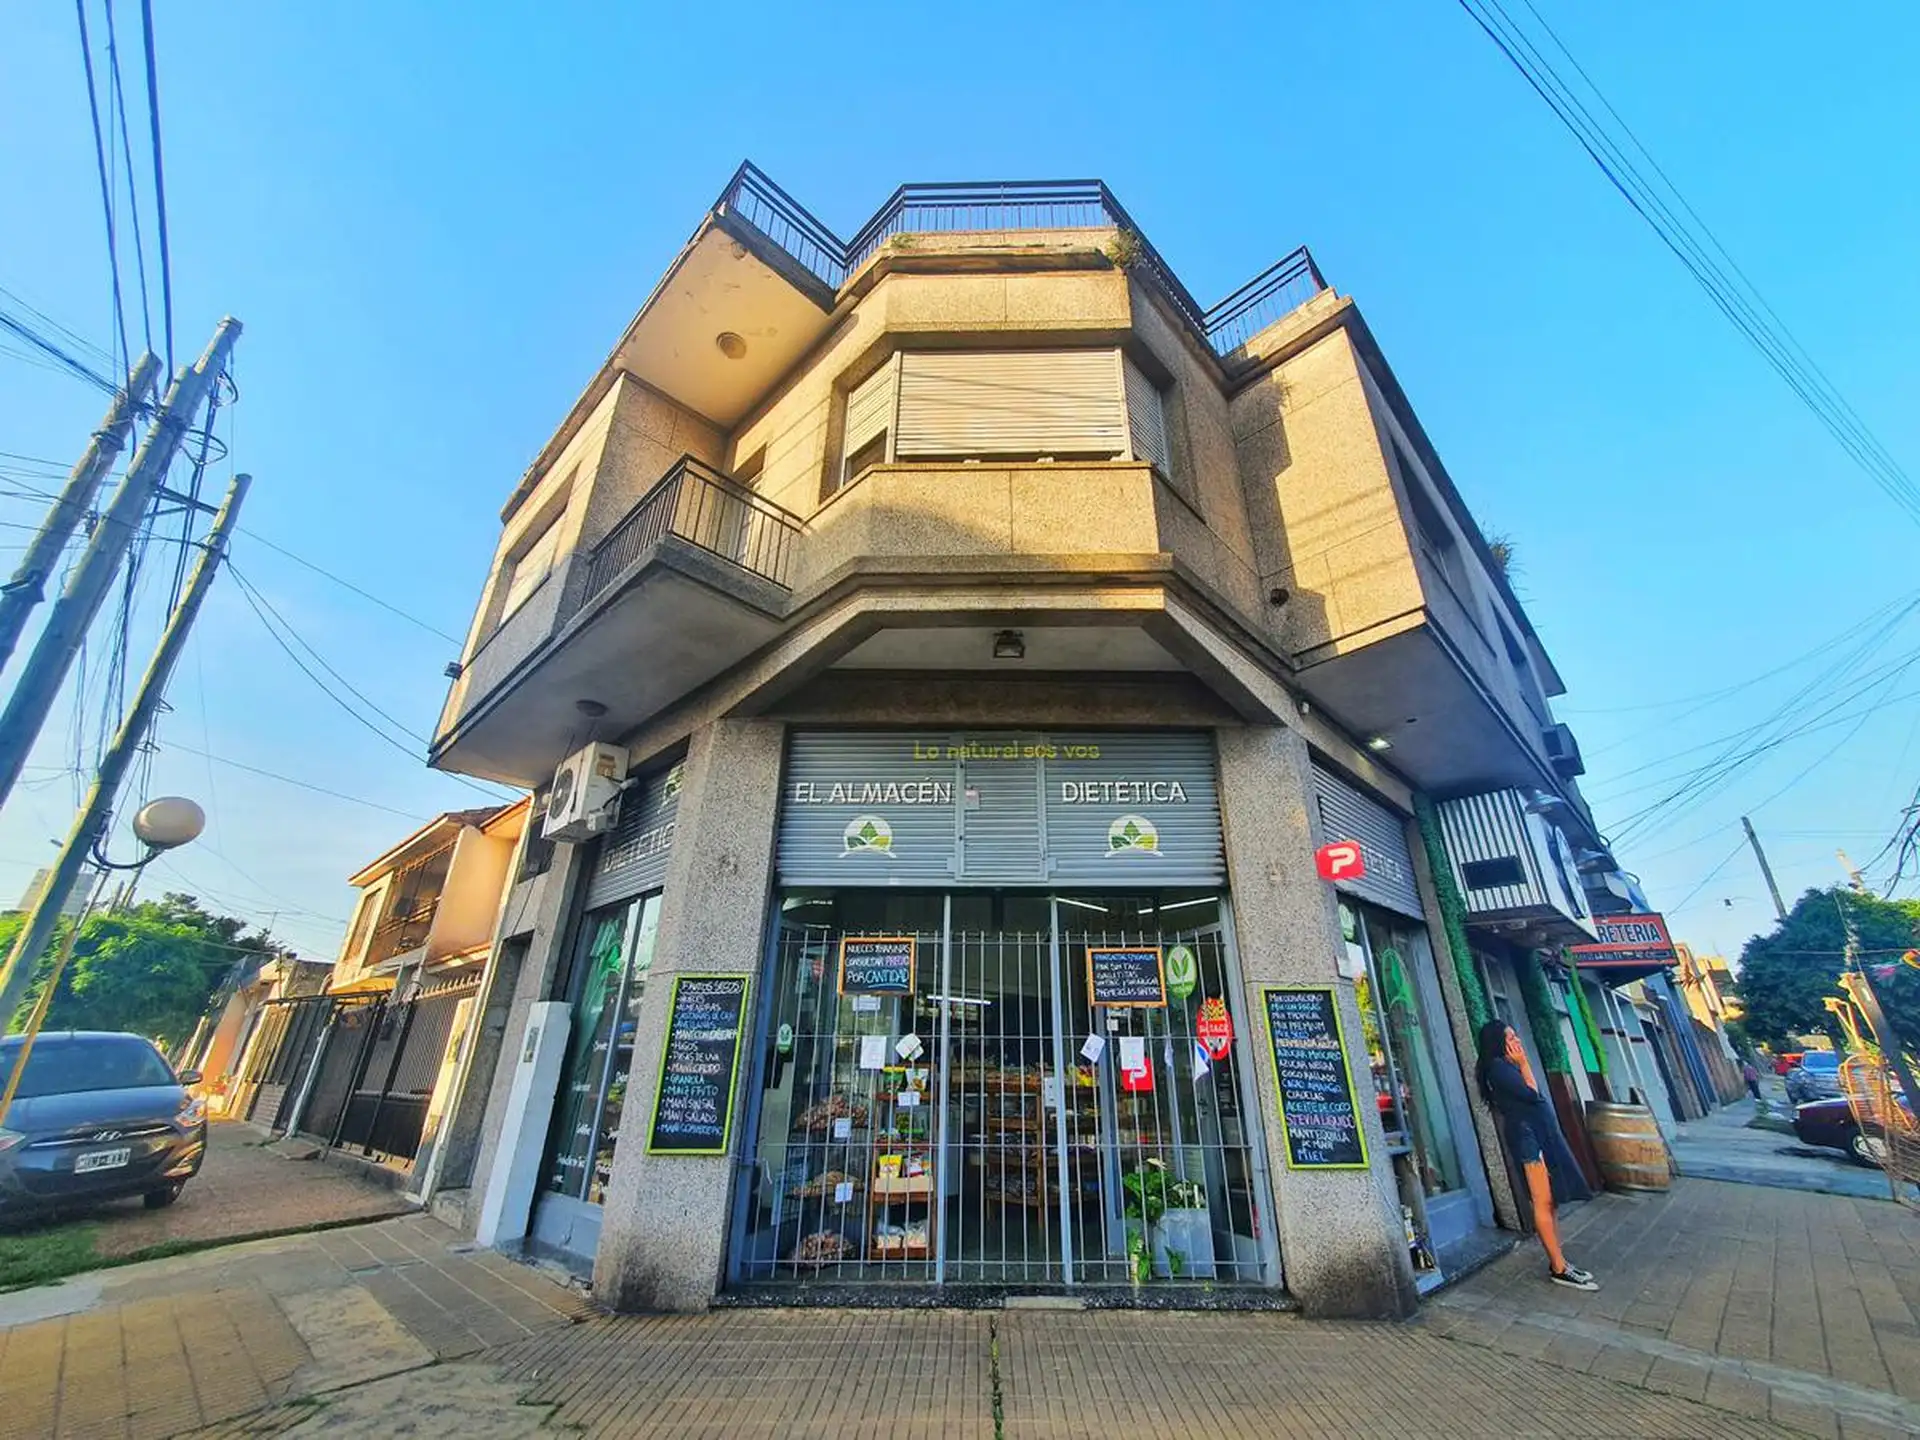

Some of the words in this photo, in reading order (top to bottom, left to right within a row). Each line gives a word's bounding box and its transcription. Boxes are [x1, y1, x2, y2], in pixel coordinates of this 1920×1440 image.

[913, 740, 939, 760] Lo
[946, 740, 1018, 759] natural
[1023, 743, 1057, 759] sos
[1063, 744, 1100, 759] vos
[794, 781, 822, 803] EL
[828, 775, 953, 804] ALMACÉN
[1062, 775, 1189, 803] DIETÉTICA
[846, 970, 865, 983] POR
[866, 968, 910, 984] CANTIDAD
[685, 1110, 718, 1124] SALADO
[1286, 1112, 1321, 1126] STEVIA
[1289, 1127, 1351, 1143] MANTEQUILLA
